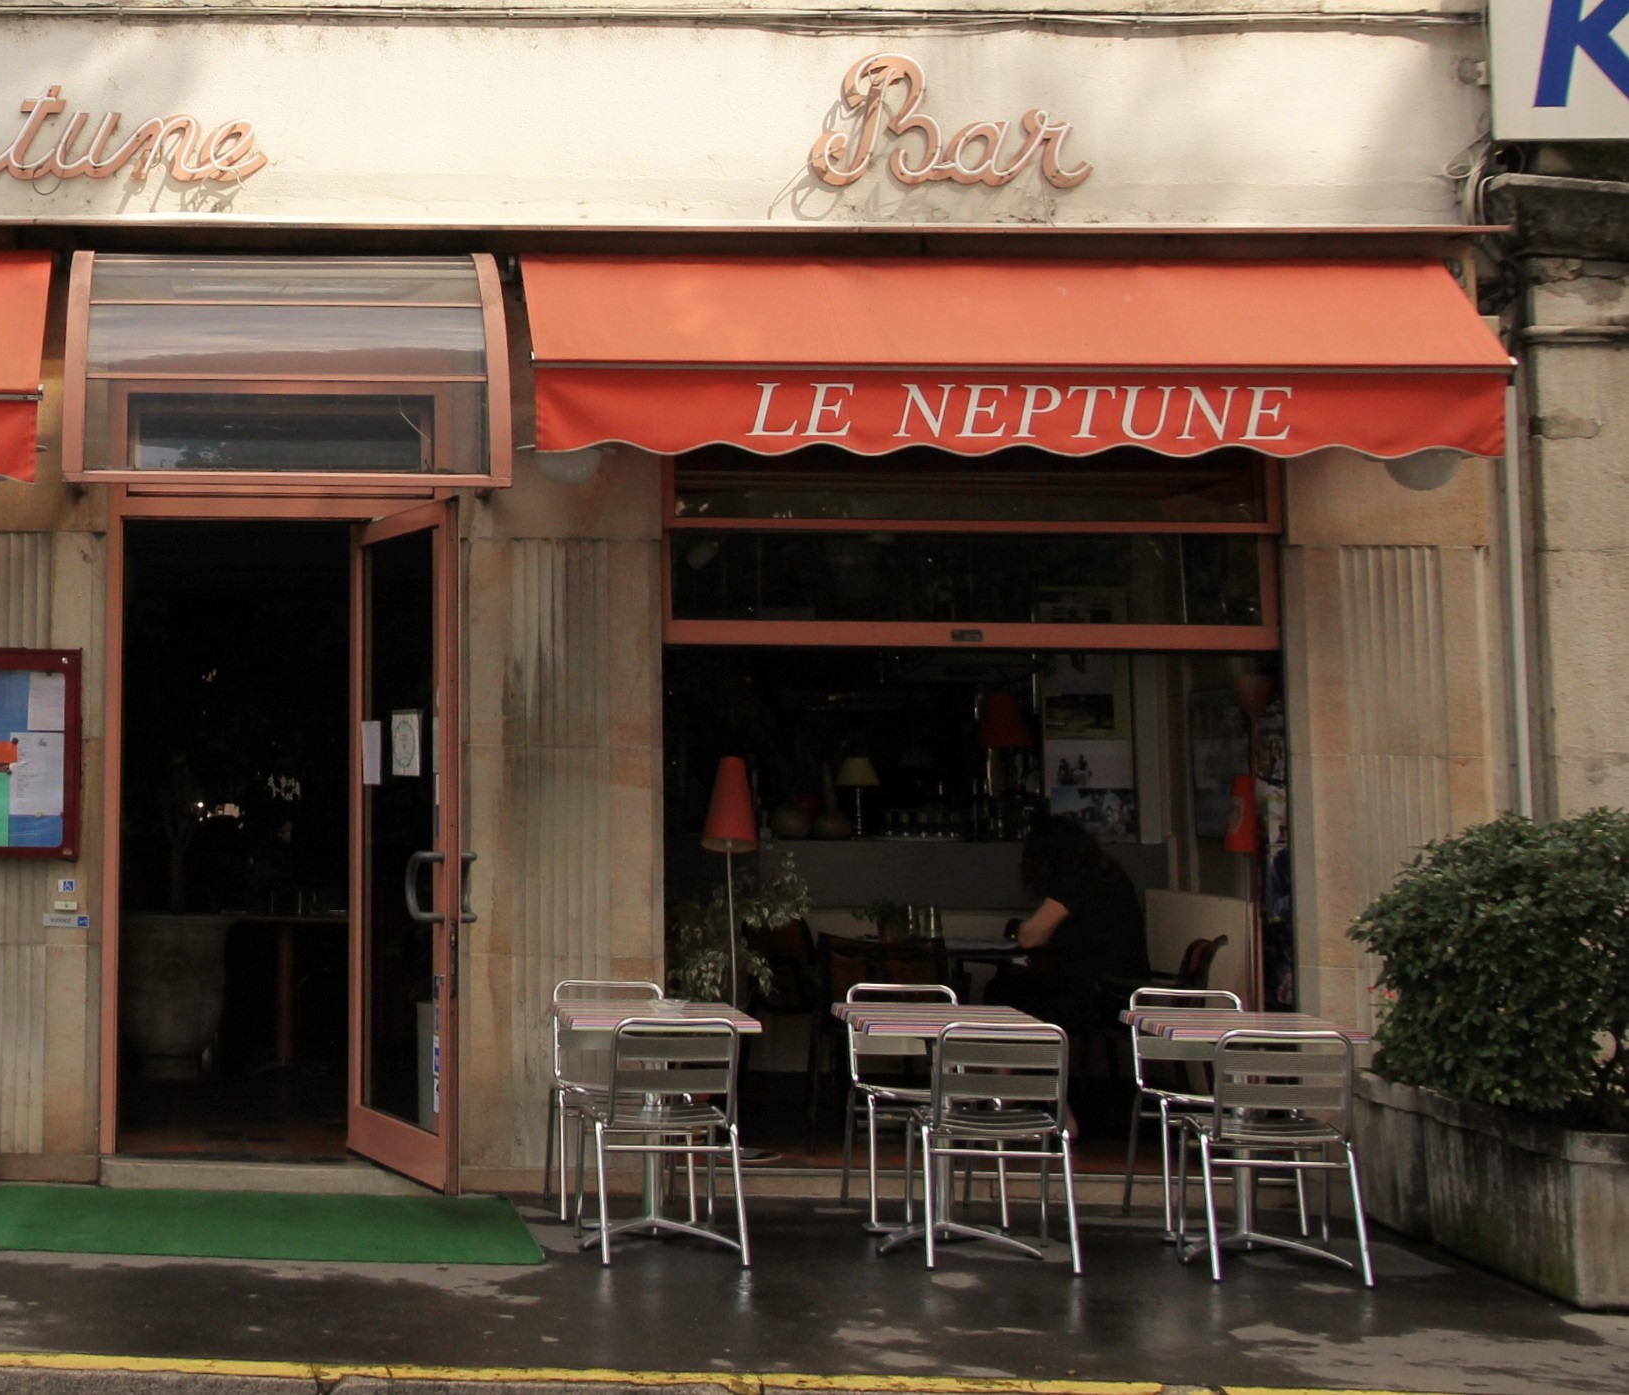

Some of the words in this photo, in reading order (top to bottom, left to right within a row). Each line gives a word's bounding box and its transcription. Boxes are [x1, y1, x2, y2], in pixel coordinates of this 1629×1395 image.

[808, 52, 1095, 190] Bar
[746, 382, 854, 437] LE
[892, 383, 1293, 441] NEPTUNE
